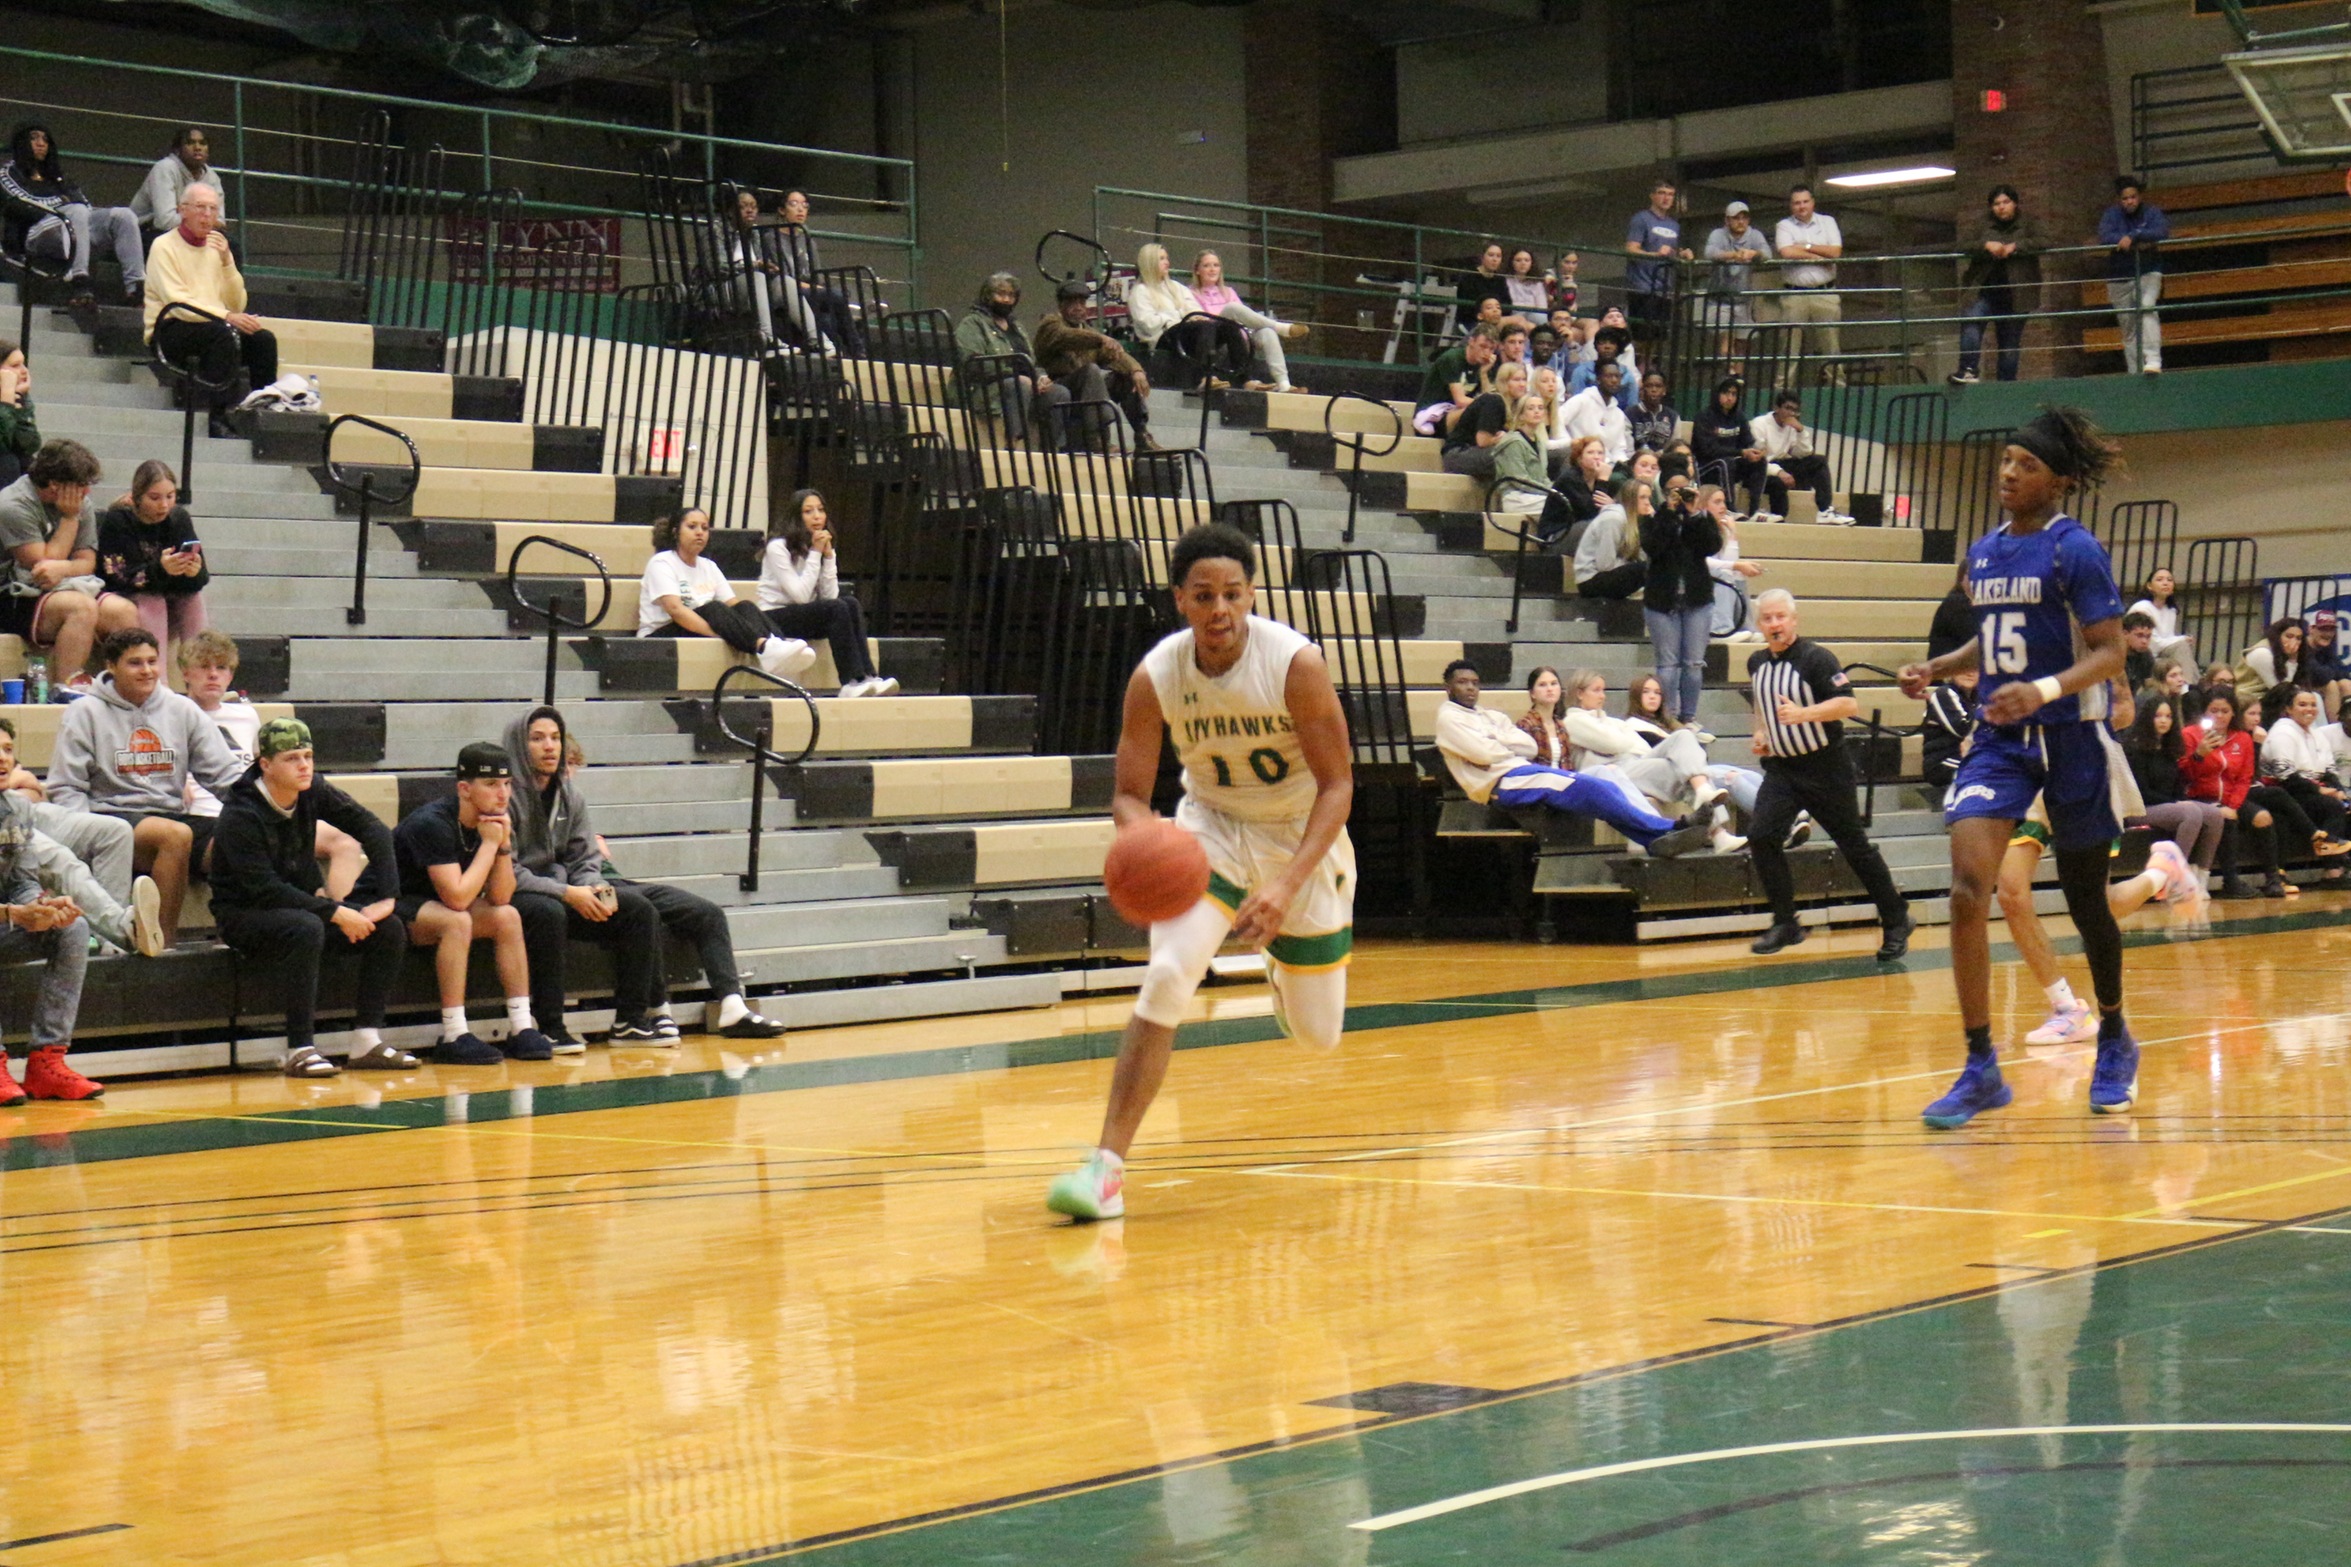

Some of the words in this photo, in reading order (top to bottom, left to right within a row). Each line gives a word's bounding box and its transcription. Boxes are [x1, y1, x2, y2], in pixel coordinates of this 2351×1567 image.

[1970, 576, 2042, 606] LAKELAND
[1982, 611, 2029, 675] 15
[1211, 748, 1290, 787] 10
